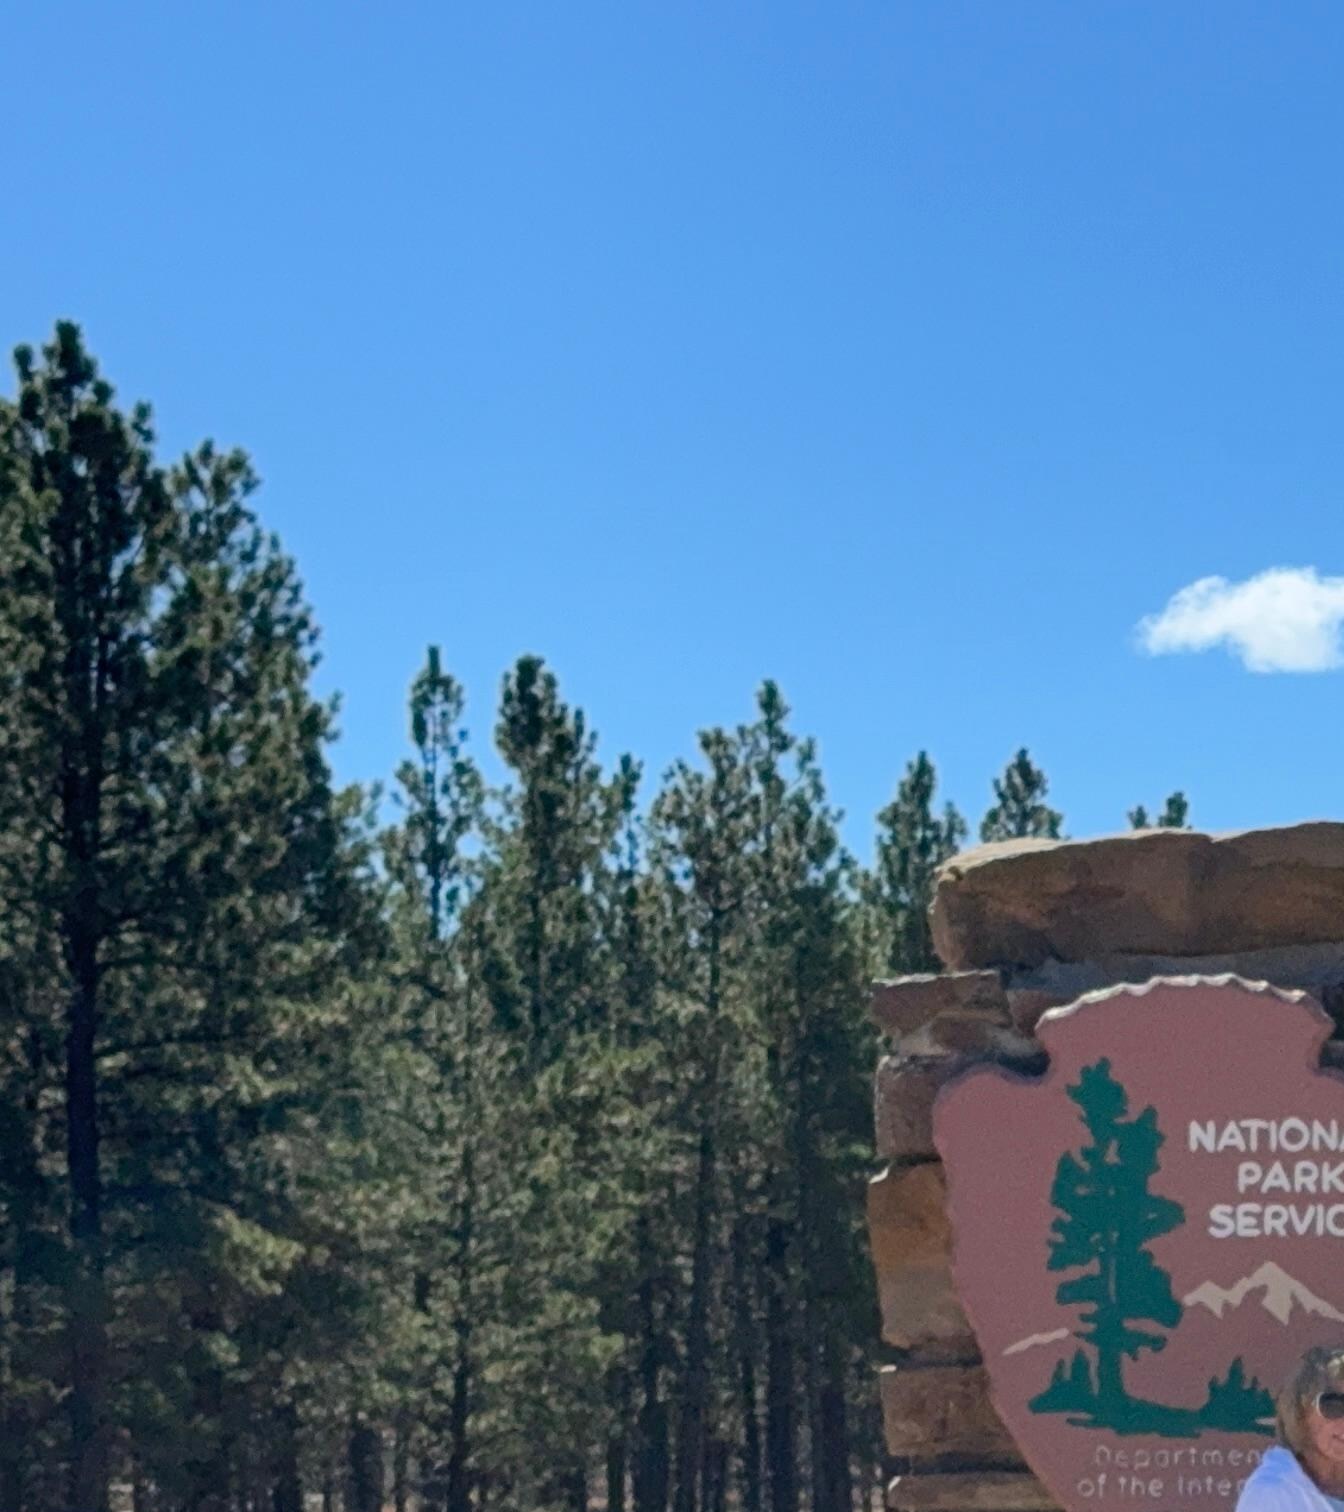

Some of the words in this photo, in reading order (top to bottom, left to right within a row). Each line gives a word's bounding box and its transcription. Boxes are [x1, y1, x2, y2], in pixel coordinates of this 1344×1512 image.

[1095, 1445, 1262, 1470] Departmen
[1077, 1473, 1107, 1498] of
[1119, 1474, 1164, 1498] the
[1178, 1474, 1247, 1497] Inter
